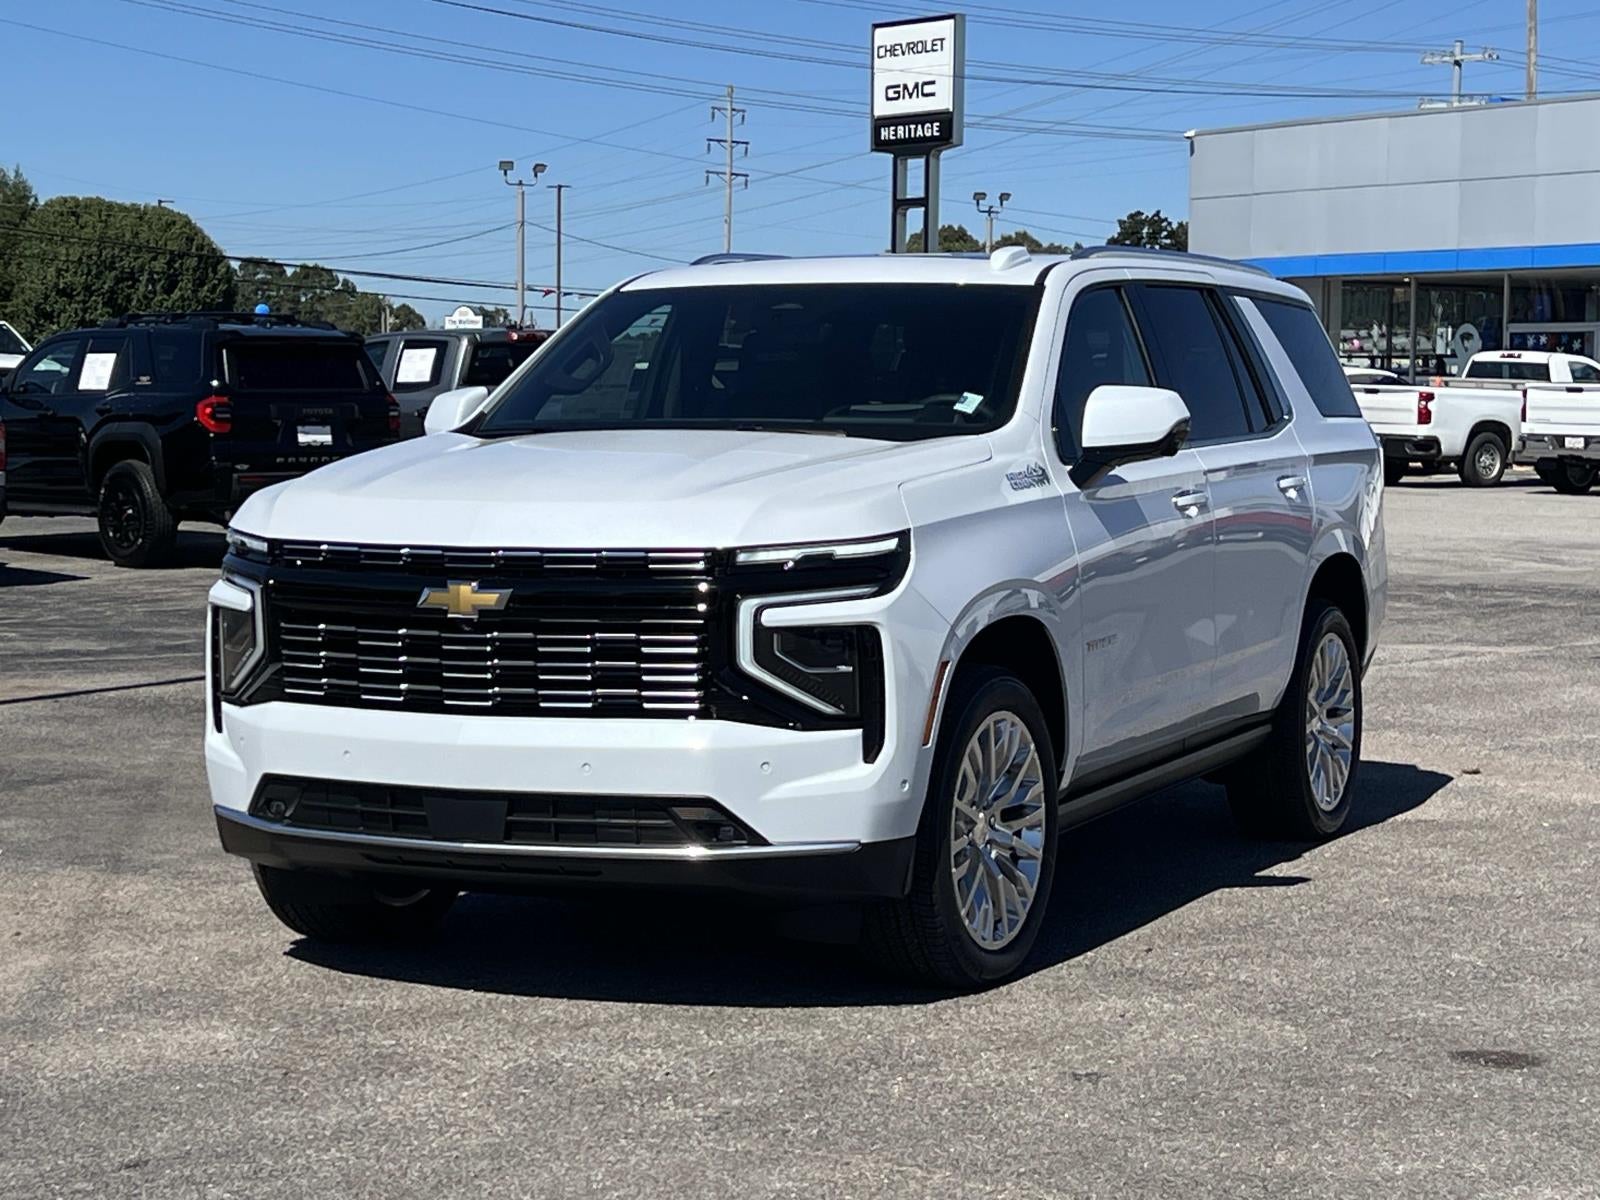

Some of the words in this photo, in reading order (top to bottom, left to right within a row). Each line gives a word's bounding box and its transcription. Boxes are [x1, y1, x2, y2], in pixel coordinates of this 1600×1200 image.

[876, 37, 946, 59] CHEVROLET
[885, 80, 936, 101] GMC
[880, 122, 941, 141] HERITAGE
